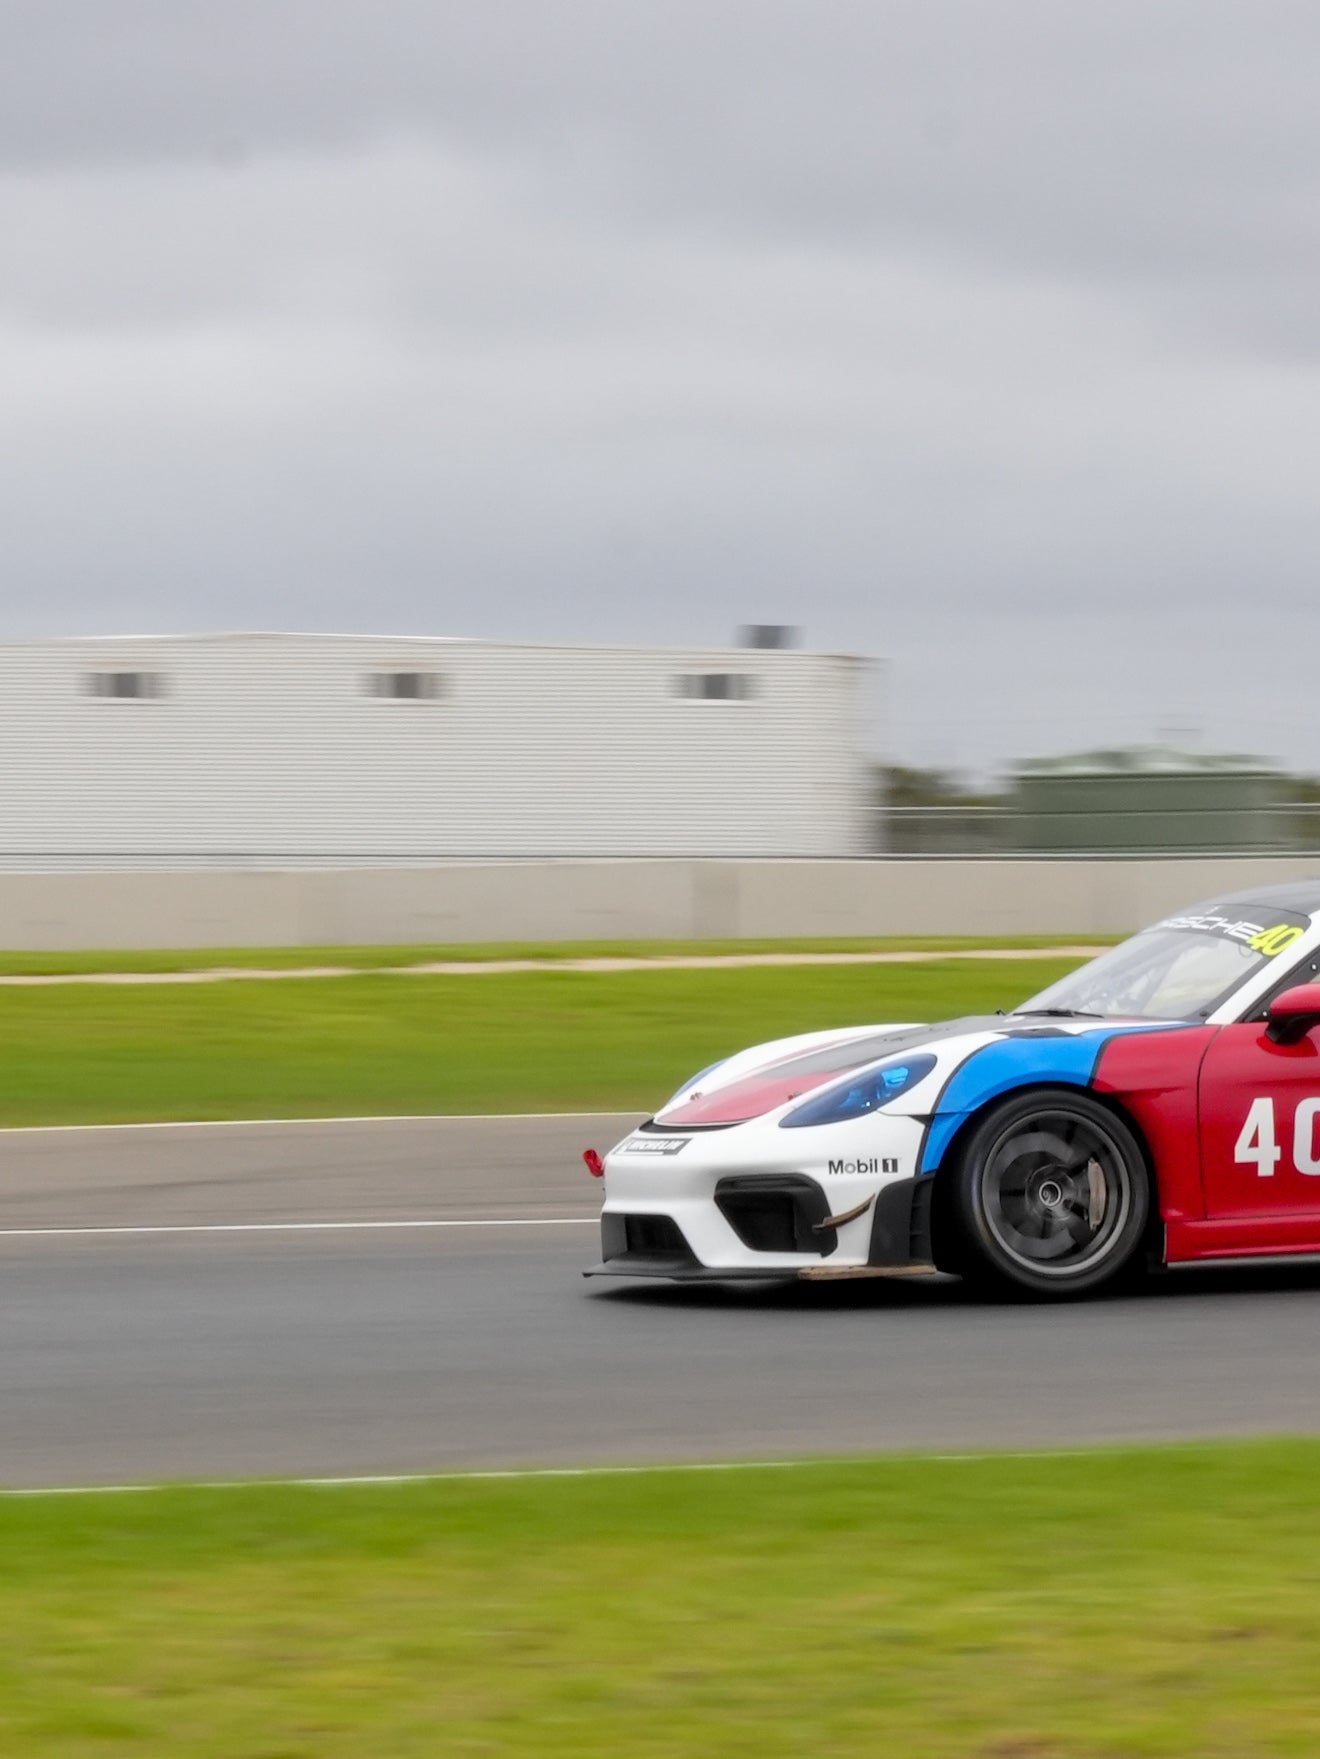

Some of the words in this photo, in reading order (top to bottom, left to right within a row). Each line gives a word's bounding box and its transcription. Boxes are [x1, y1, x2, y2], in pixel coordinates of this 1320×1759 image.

[1246, 924, 1304, 956] 40
[828, 1159, 878, 1175] Mobil
[882, 1158, 898, 1173] 1
